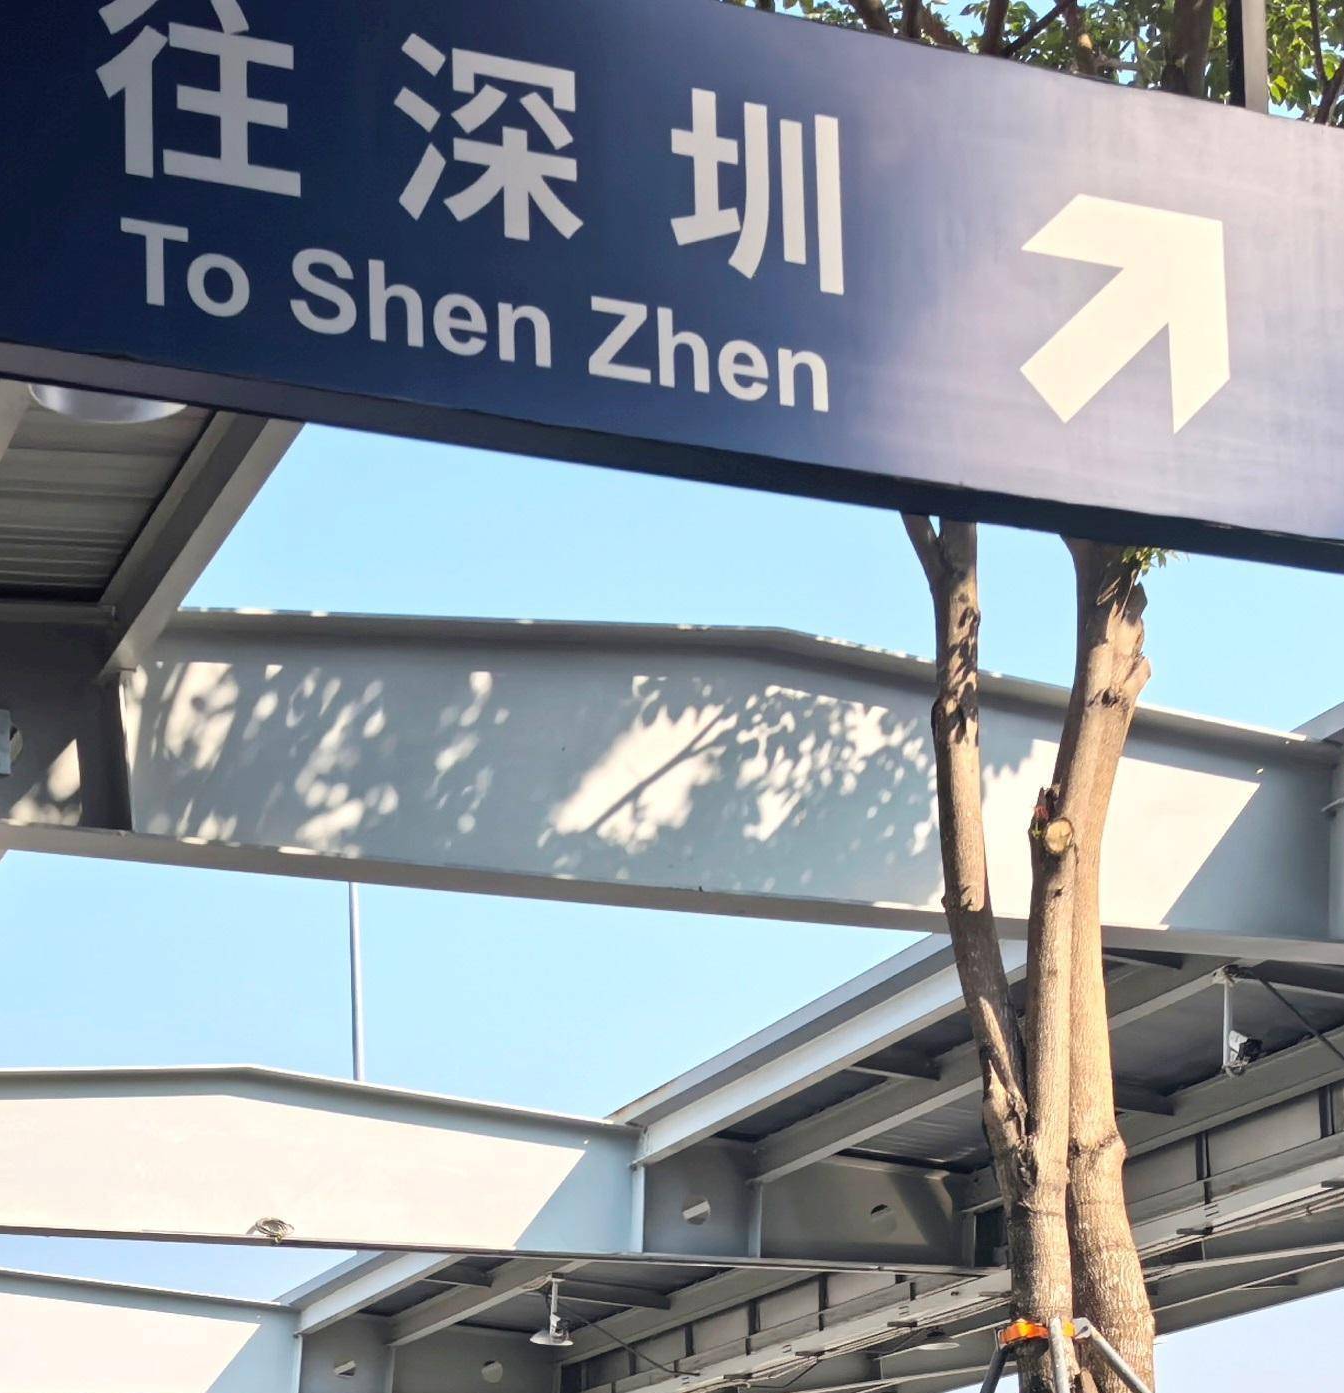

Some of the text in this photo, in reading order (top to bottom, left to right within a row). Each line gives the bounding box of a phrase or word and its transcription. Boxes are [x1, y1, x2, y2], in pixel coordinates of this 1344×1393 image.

[95, 0, 845, 296] 往深圳
[120, 217, 830, 413] To Shen Zhen
